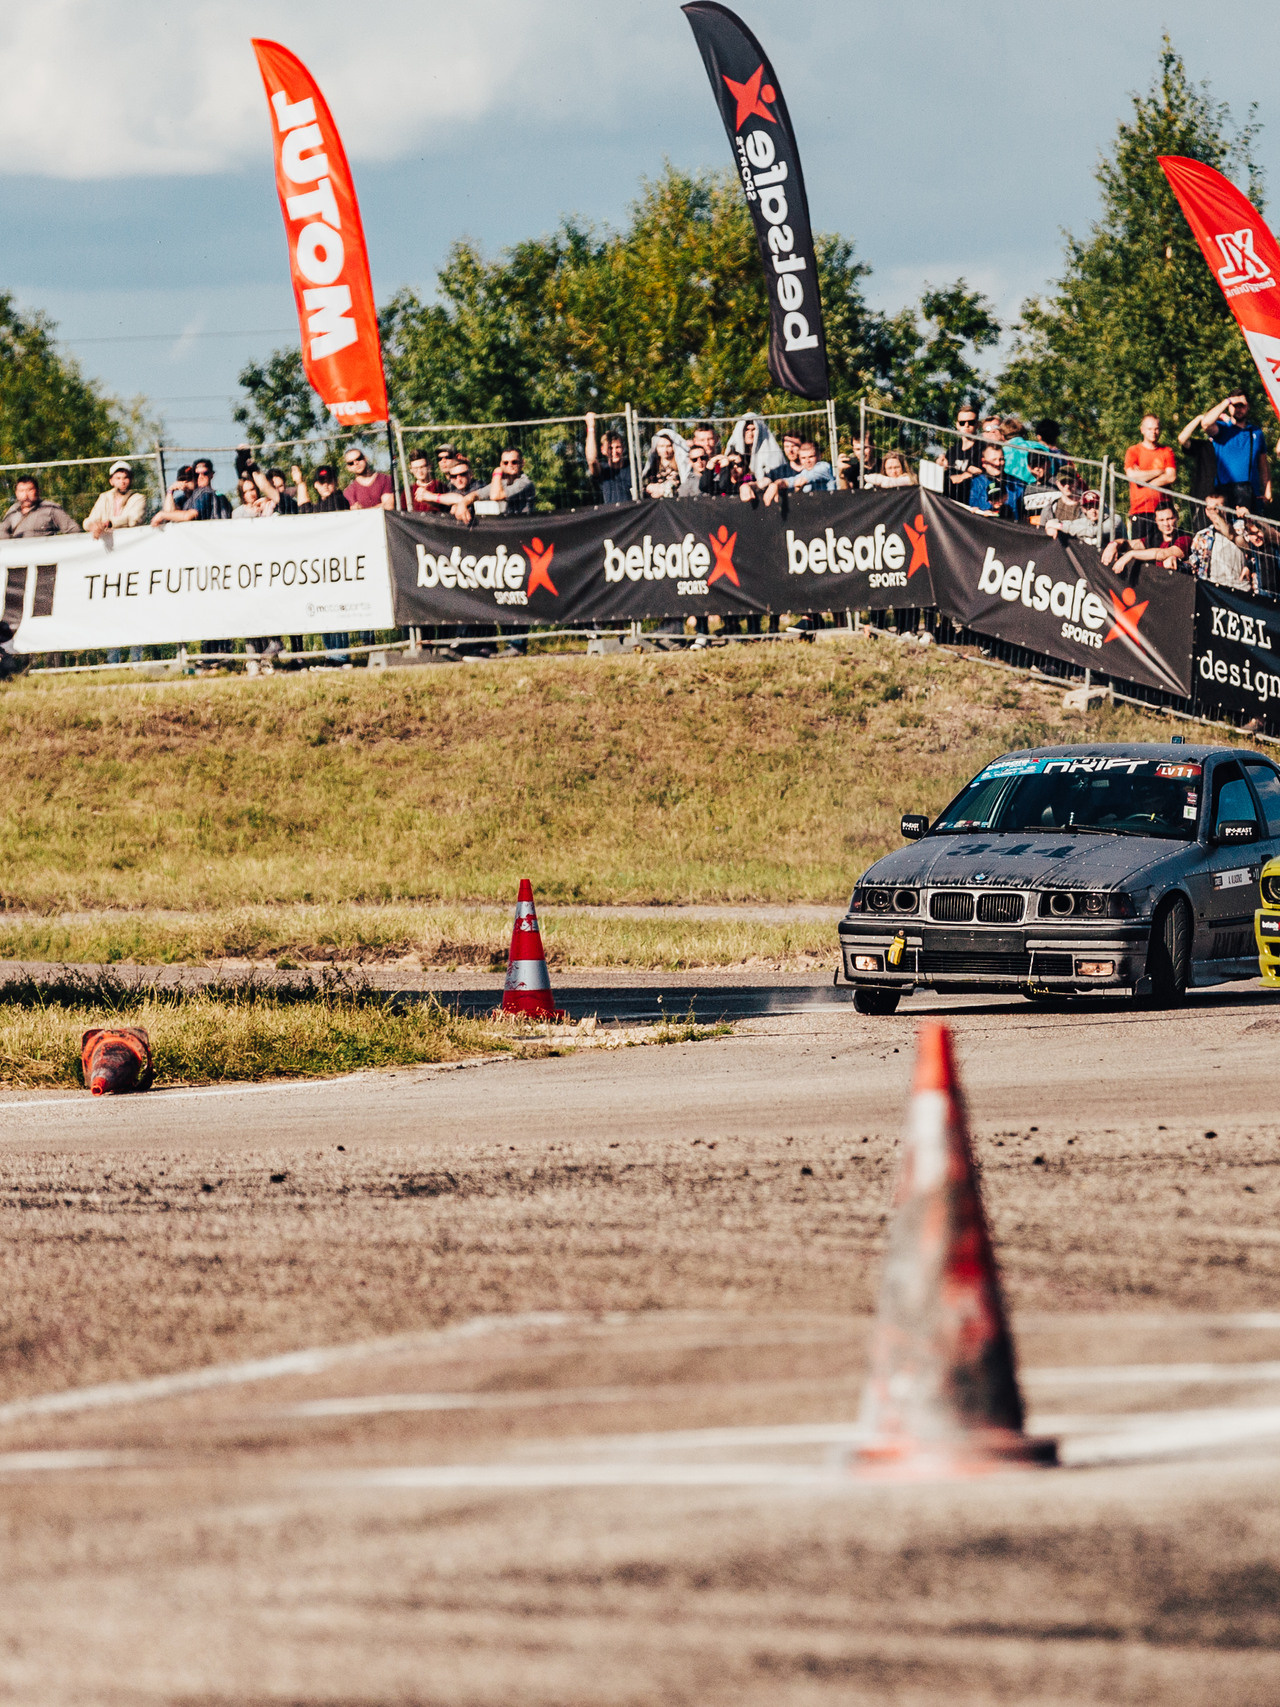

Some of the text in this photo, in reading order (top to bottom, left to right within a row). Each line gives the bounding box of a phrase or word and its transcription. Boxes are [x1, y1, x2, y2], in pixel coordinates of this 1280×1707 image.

[416, 543, 526, 590] betsafe
[603, 533, 711, 583] betsafe
[786, 524, 906, 574] betsafe
[84, 555, 366, 600] THE FUTURE OF POSSIBLE
[494, 590, 528, 605] SPORTS
[677, 580, 709, 596] SPORTS
[868, 572, 907, 589] SPORTS
[978, 546, 1108, 630] betsafe
[1061, 622, 1103, 649] SPORTS
[1211, 606, 1272, 649] KEEL
[948, 843, 1076, 858] 344
